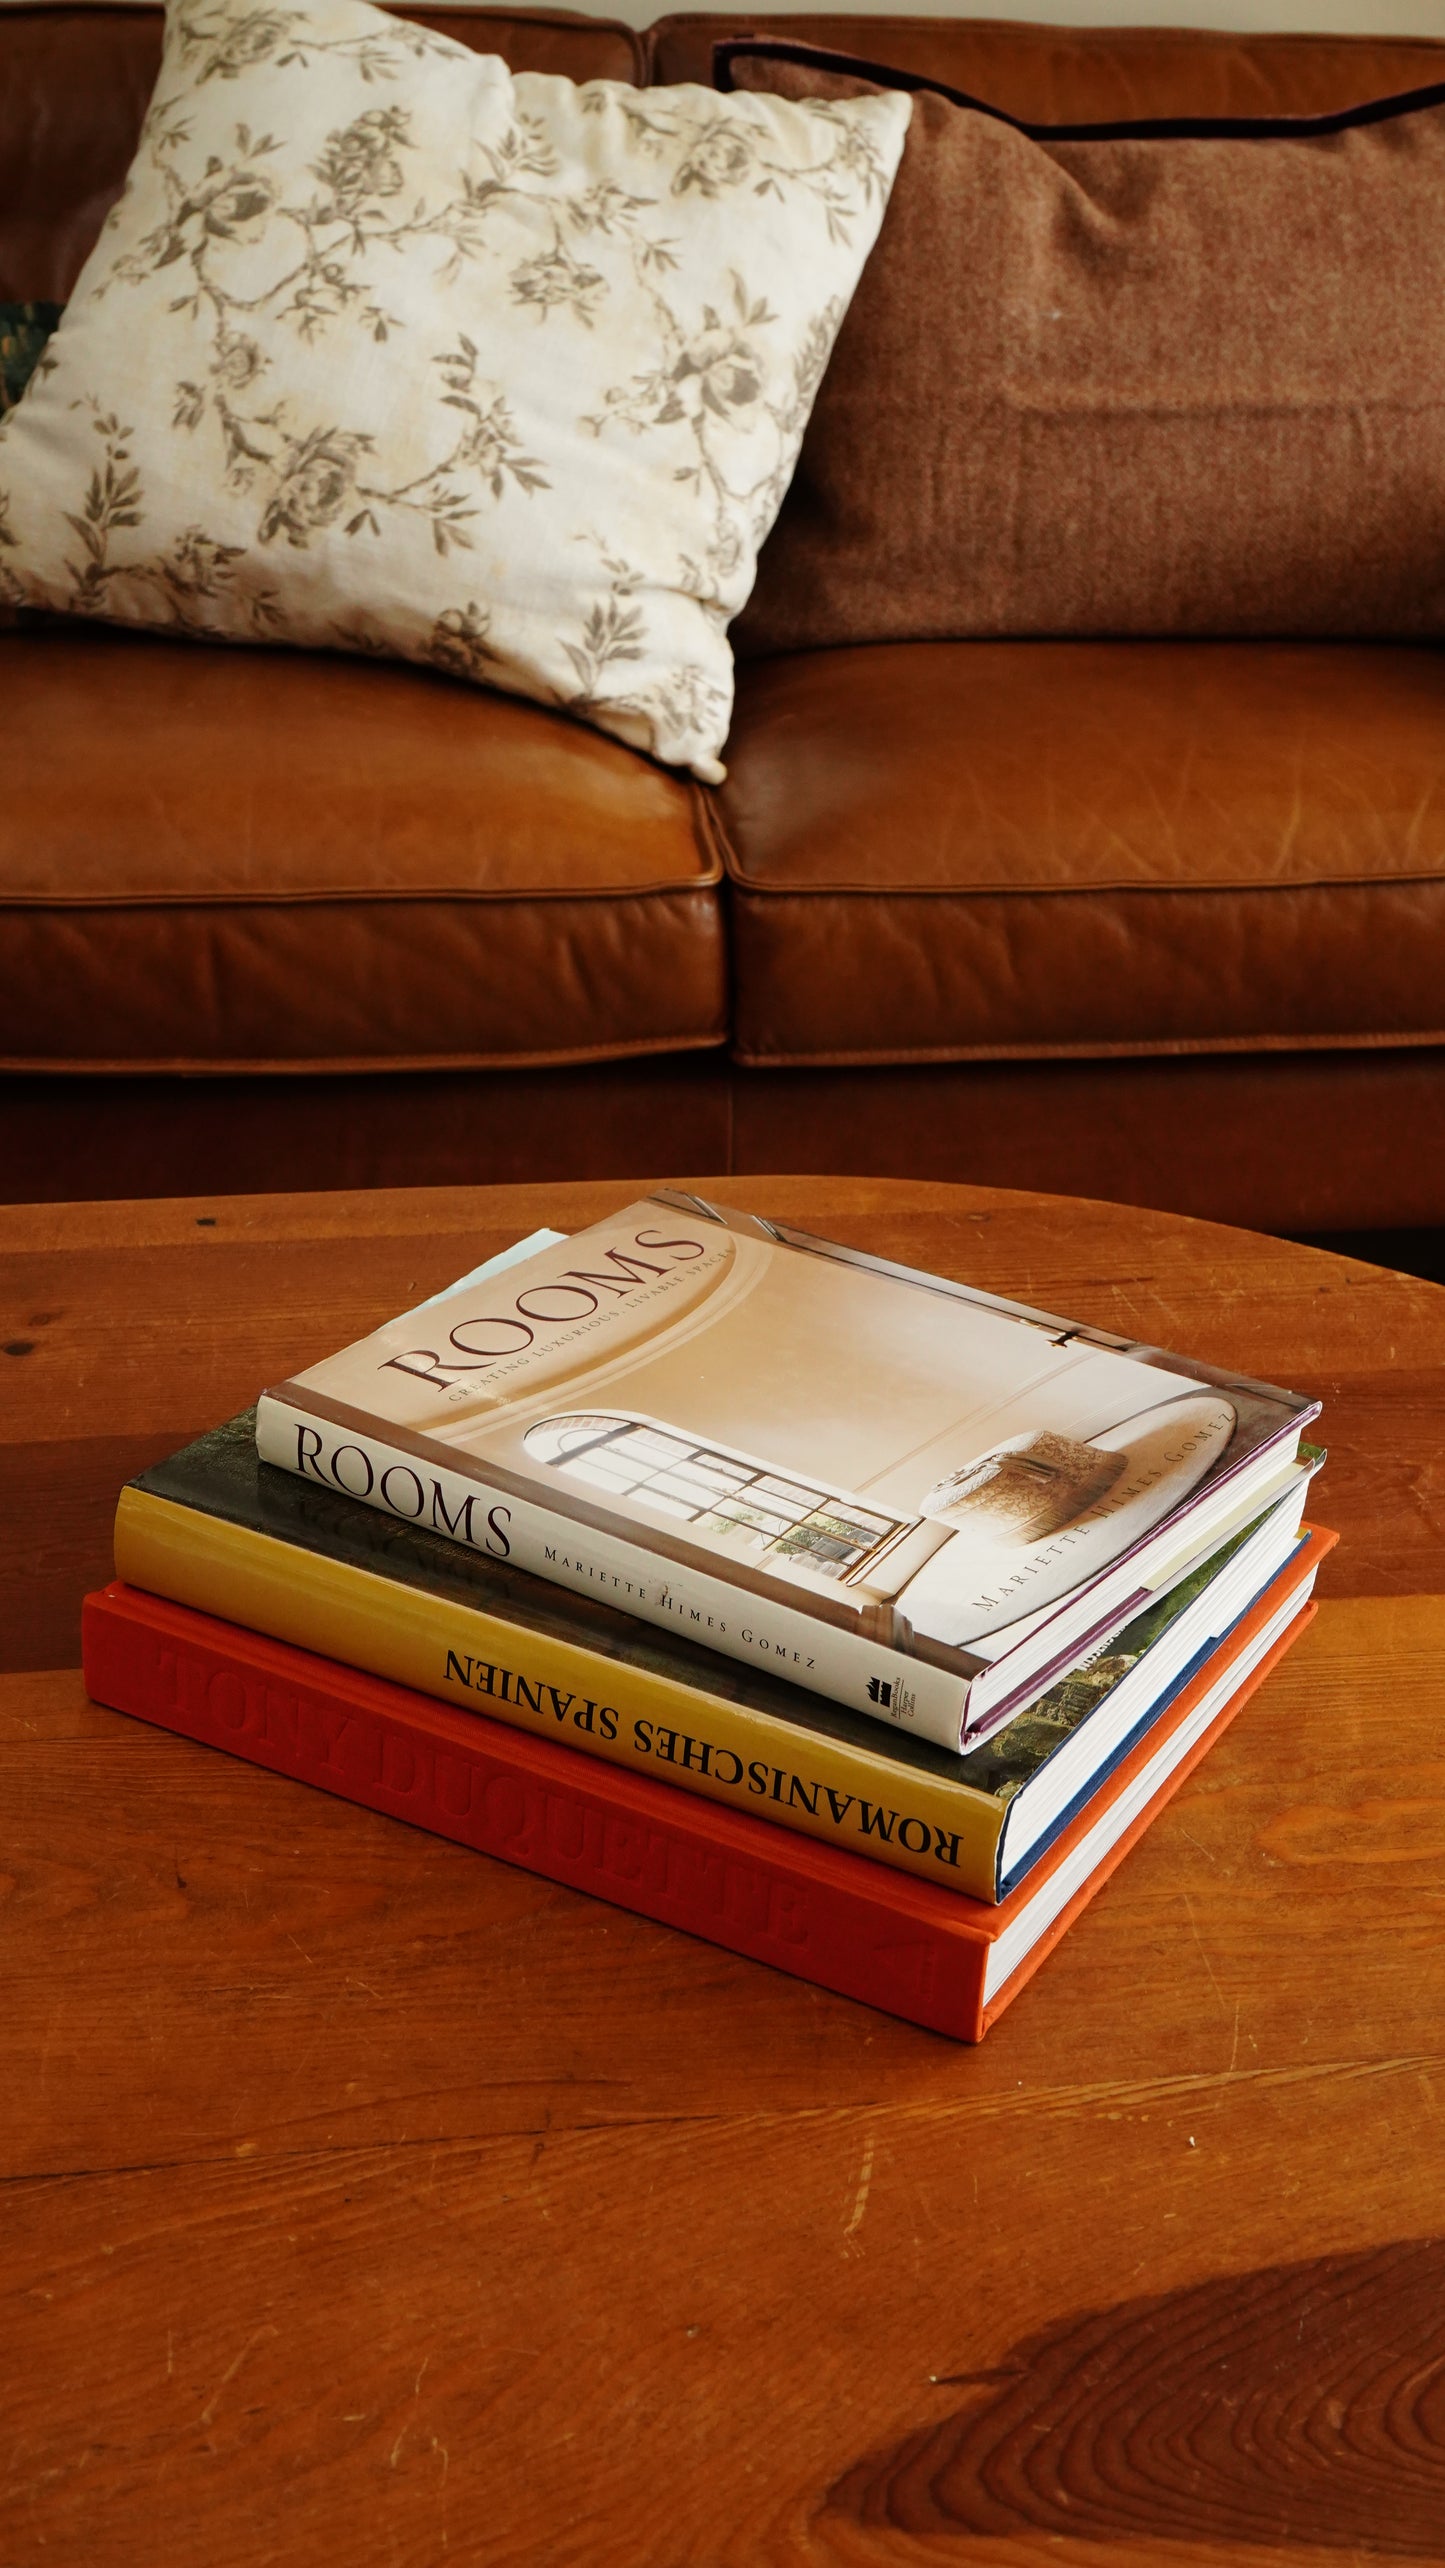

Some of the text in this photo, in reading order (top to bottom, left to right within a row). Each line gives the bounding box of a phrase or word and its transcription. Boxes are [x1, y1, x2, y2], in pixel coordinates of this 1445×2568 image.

[378, 1229, 705, 1392] ROOMS
[449, 1357, 531, 1402] CREATING
[626, 1276, 686, 1310] LIVABLE
[294, 1423, 513, 1558] ROOMS
[971, 1409, 1235, 1612] MARIETTE HIMES GOMEZ
[544, 1546, 816, 1670] MARIETTE HIMES GOMEZ
[154, 1643, 811, 1948] TONY DUQUETTE
[443, 1649, 964, 1868] ROMANISCHES SPANIEN
